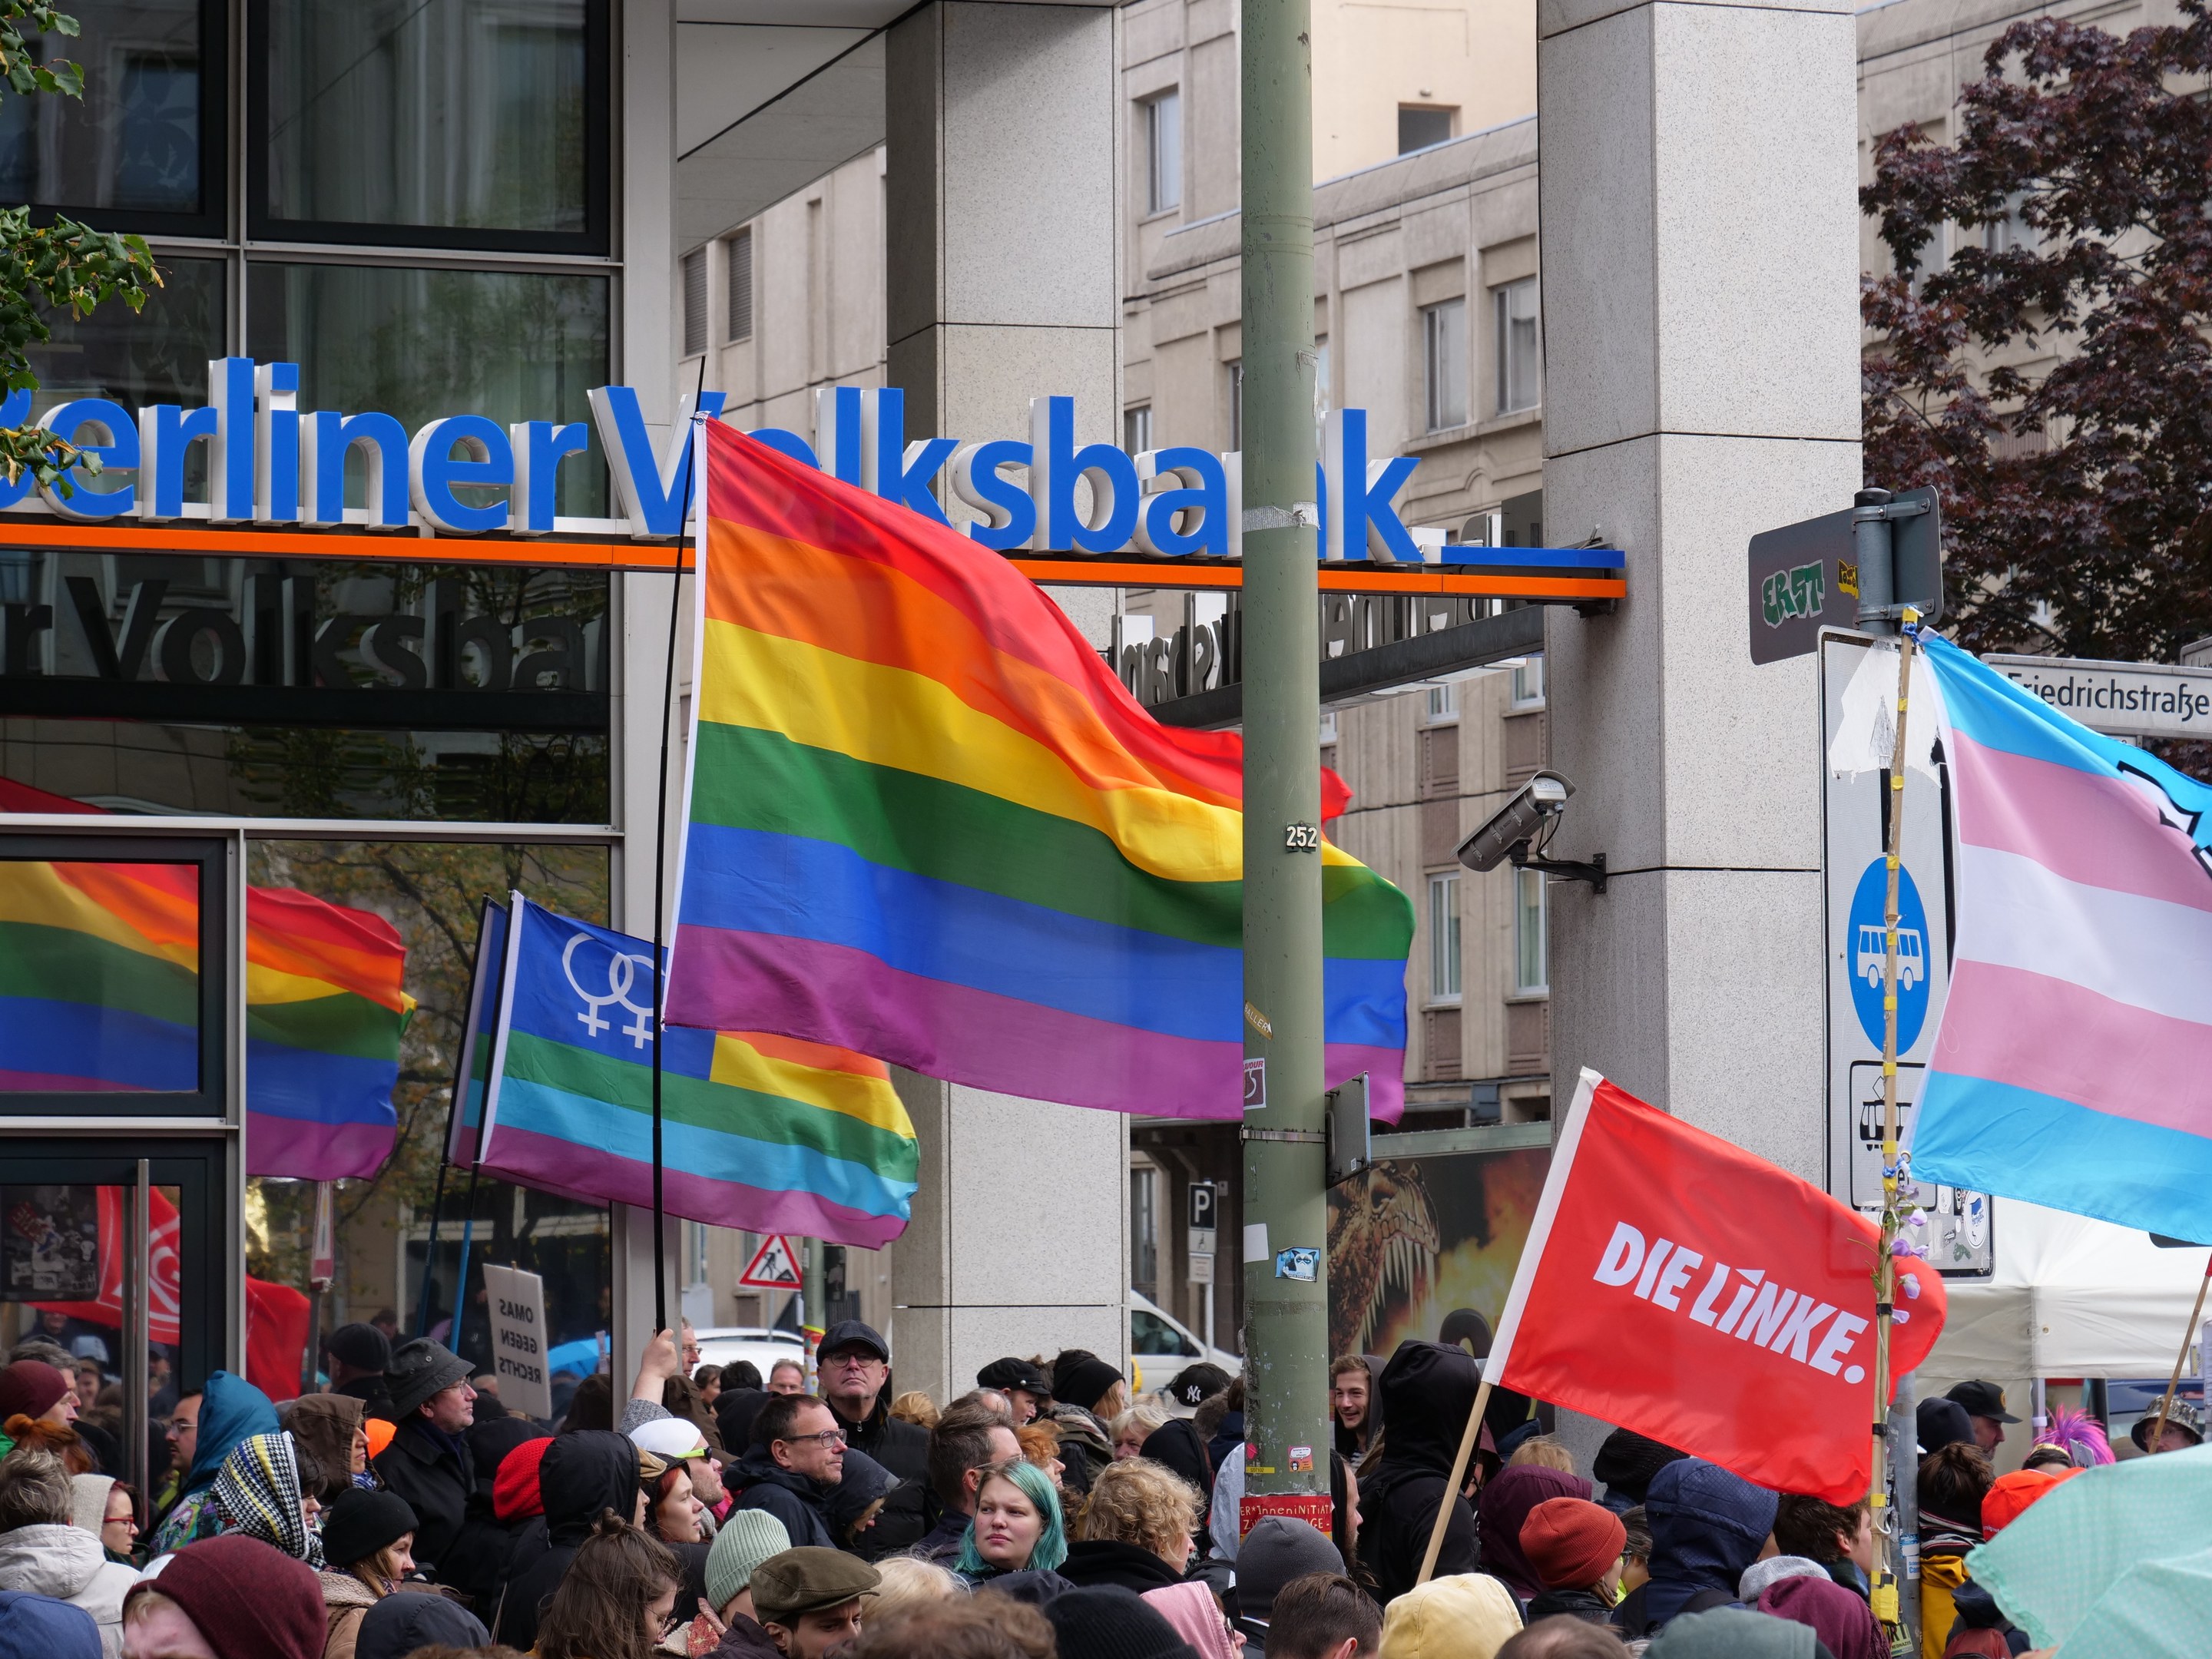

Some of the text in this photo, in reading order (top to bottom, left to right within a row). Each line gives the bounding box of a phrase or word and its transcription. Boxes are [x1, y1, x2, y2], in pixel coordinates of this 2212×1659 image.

[1286, 826, 1317, 847] 252
[1244, 1003, 1272, 1034] BALLER
[1194, 1189, 1210, 1224] P
[1594, 1221, 1704, 1311] DIE
[1187, 1385, 1201, 1402] NY
